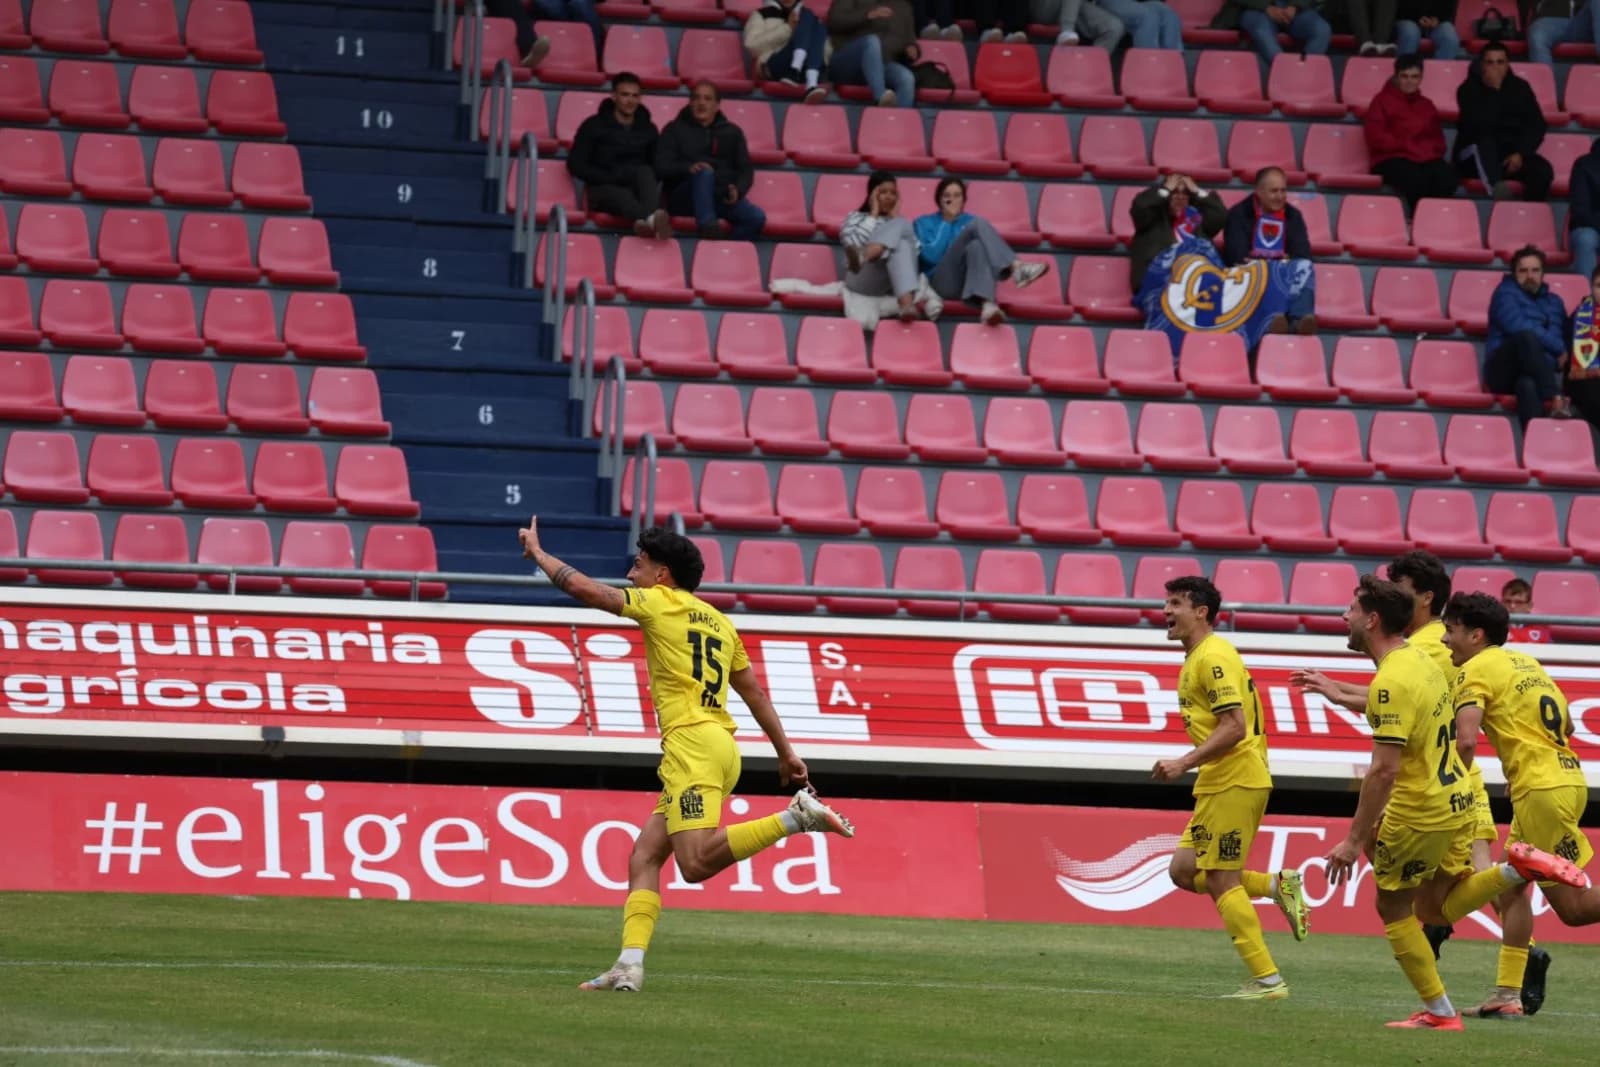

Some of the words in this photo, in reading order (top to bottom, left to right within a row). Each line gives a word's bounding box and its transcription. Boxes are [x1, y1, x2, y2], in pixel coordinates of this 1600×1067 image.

[336, 35, 364, 57] 11
[361, 108, 394, 129] 10
[397, 183, 413, 203] 9
[423, 258, 438, 277] 8
[451, 331, 466, 351] 7
[478, 405, 494, 425] 6
[505, 484, 522, 505] 5
[688, 611, 721, 633] MARCO
[687, 630, 723, 695] 15
[465, 628, 871, 741] SiL
[1539, 694, 1565, 747] 9
